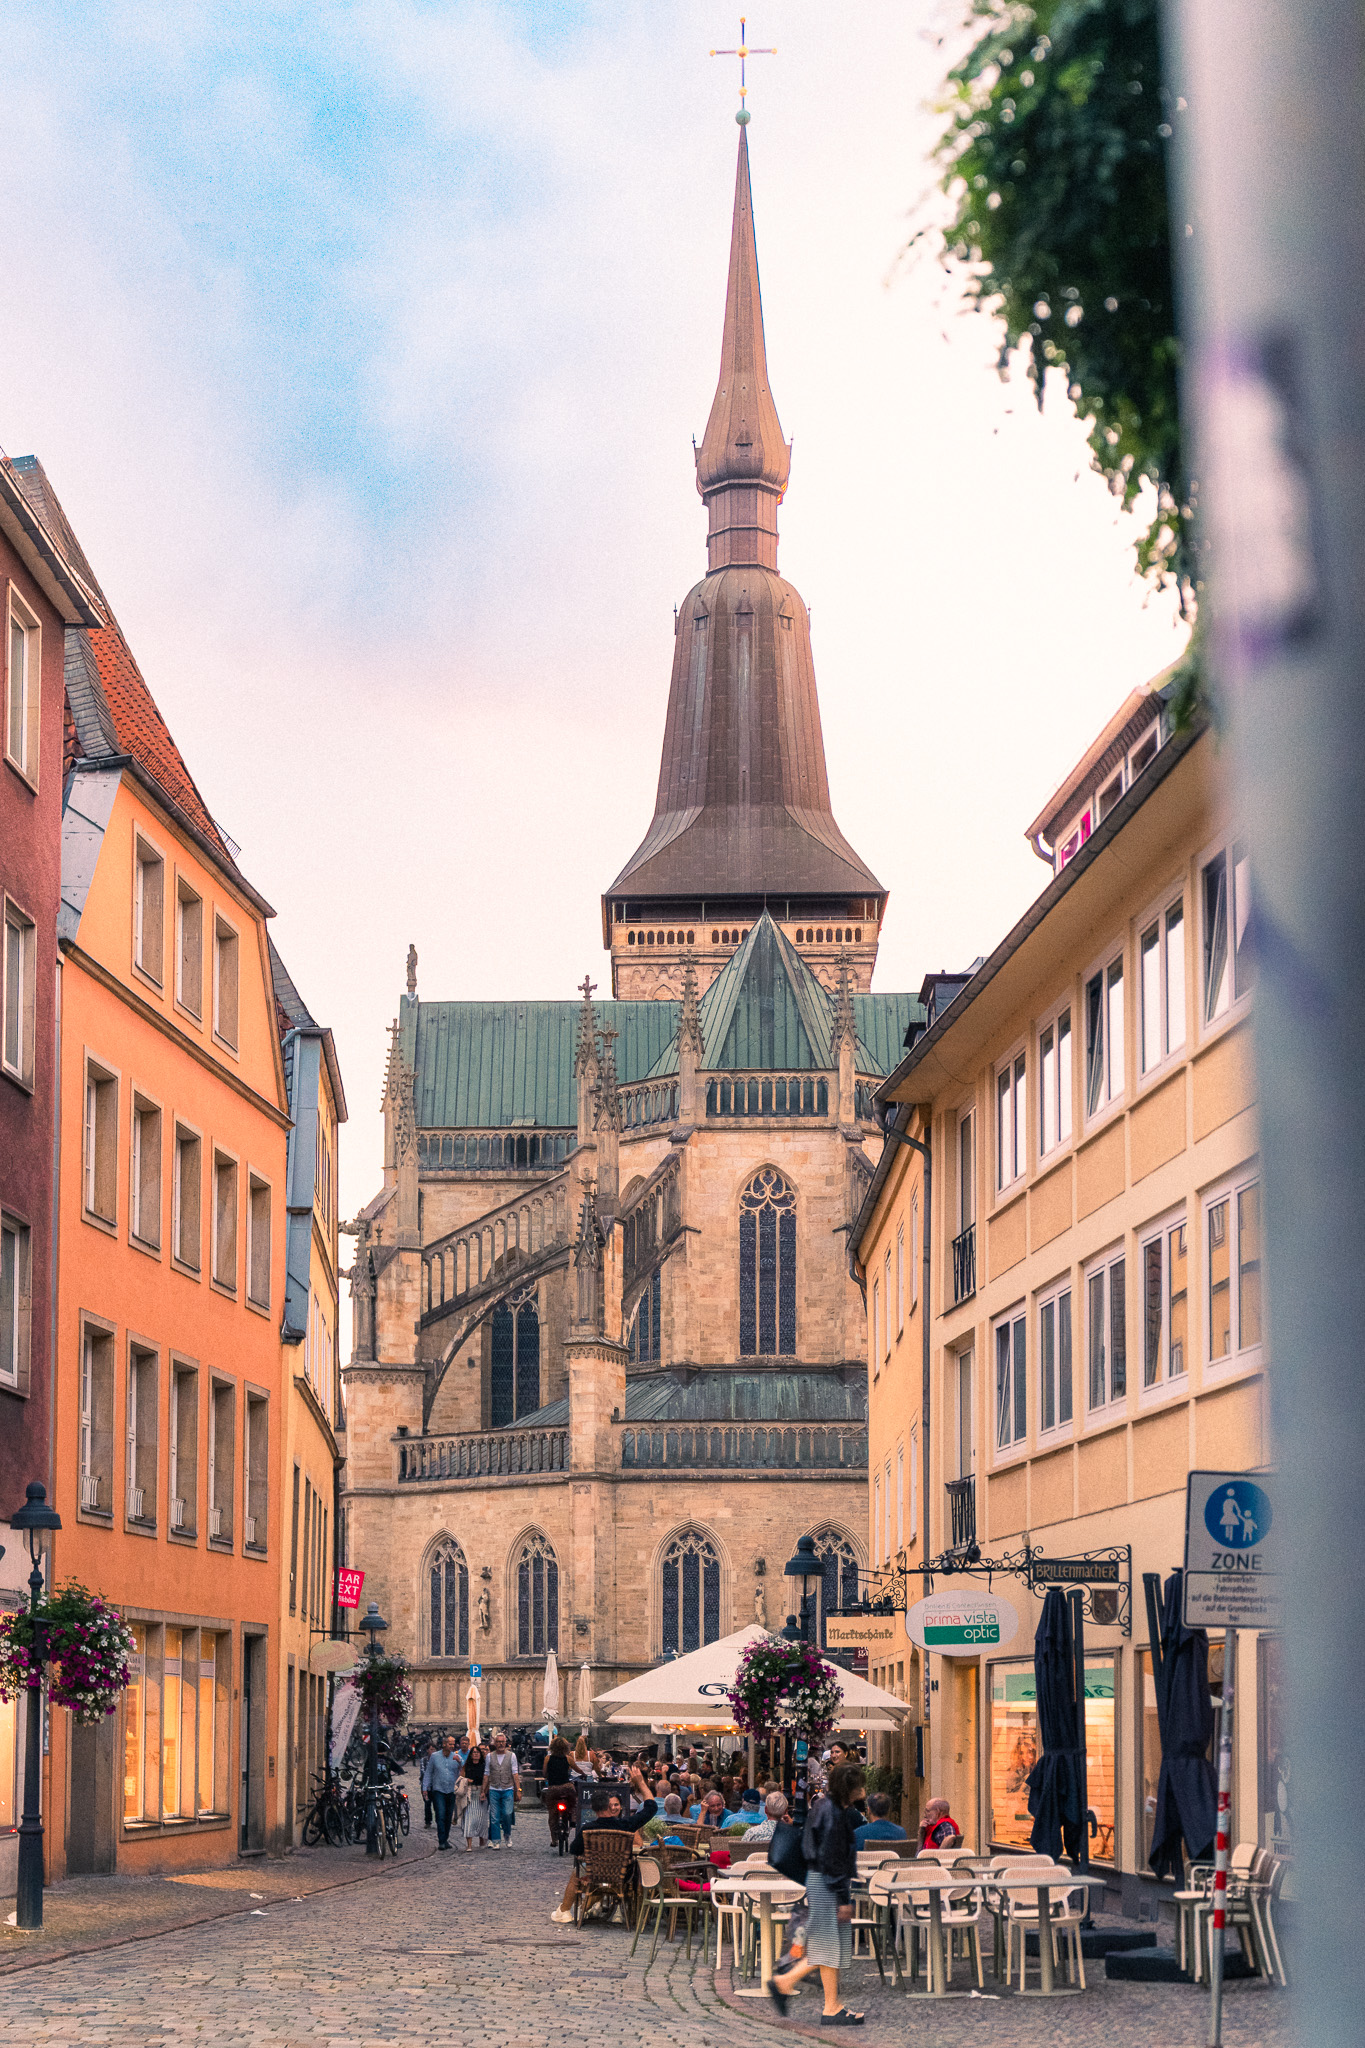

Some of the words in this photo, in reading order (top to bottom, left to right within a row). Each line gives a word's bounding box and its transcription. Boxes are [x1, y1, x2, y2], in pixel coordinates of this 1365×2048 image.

[1211, 1552, 1263, 1570] ZONE
[333, 1571, 360, 1585] LAR
[332, 1582, 359, 1596] EXT
[925, 1612, 961, 1628] prima
[963, 1610, 997, 1624] vista
[828, 1628, 894, 1641] Marktschänke
[963, 1625, 998, 1643] optic
[472, 1665, 480, 1677] P
